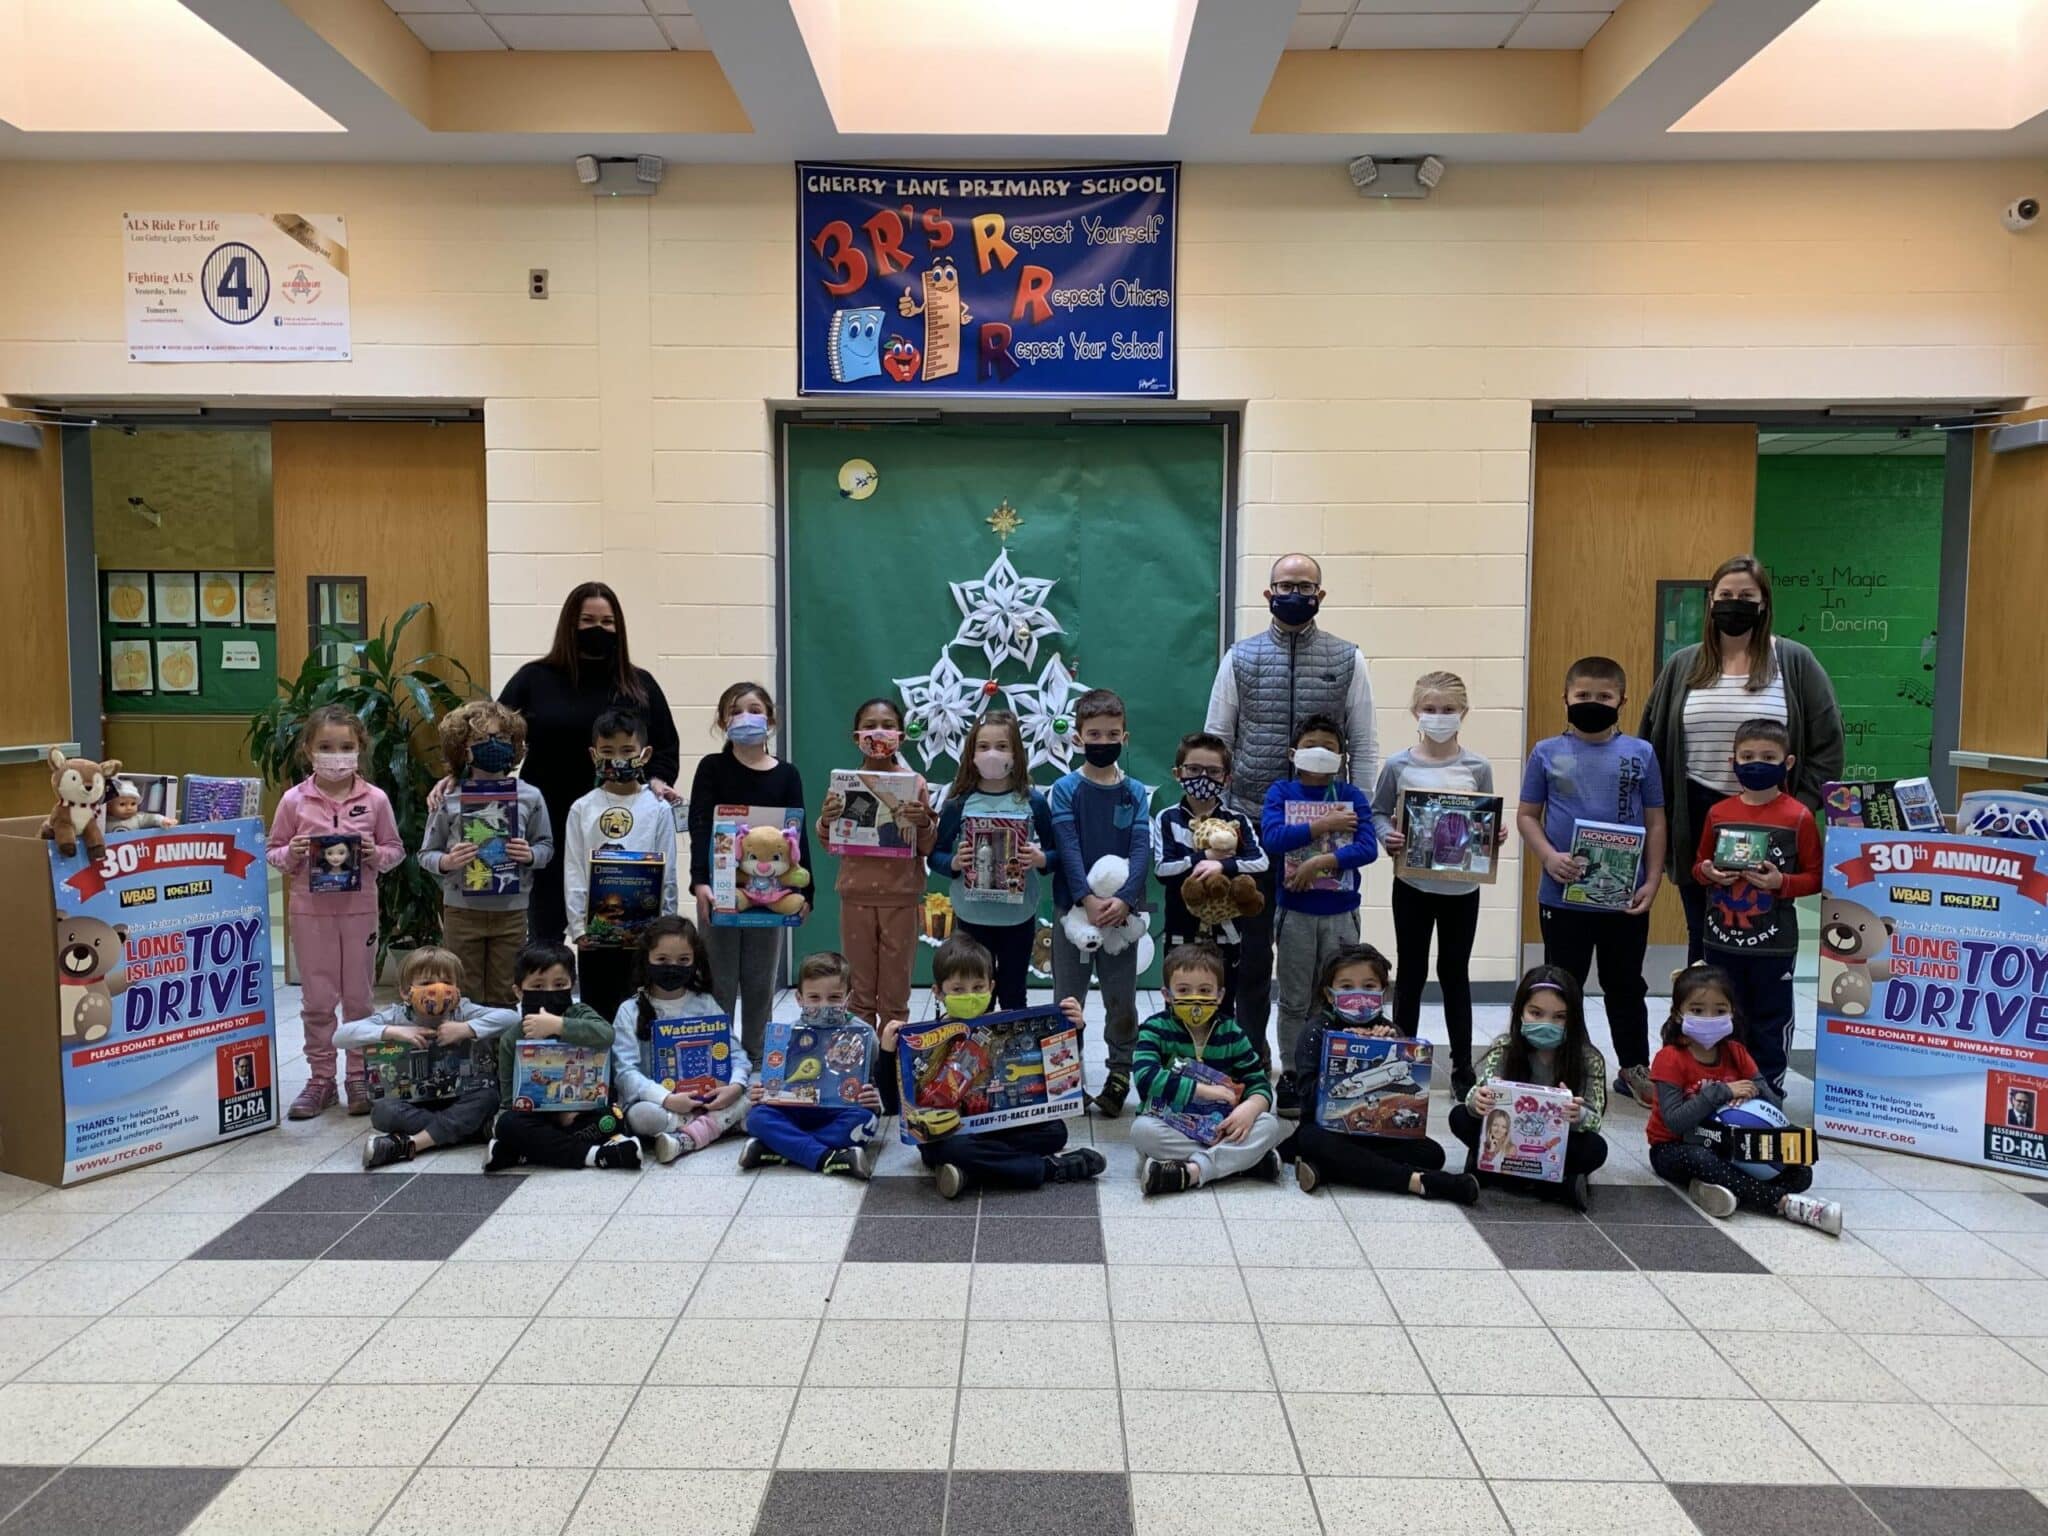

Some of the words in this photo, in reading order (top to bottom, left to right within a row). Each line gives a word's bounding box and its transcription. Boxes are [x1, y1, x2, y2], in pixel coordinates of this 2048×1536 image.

[807, 175, 886, 195] CHERRY
[897, 178, 950, 196] LANE
[959, 178, 1071, 197] PRIMARY
[1081, 175, 1166, 195] SCHOOL
[127, 220, 149, 231] ALS
[152, 219, 176, 231] Ride
[178, 219, 197, 231] For
[200, 219, 220, 231] Life
[971, 213, 1073, 275] Respect
[1081, 215, 1164, 246] Yourself
[128, 272, 169, 284] Fighting
[171, 272, 194, 283] ALS
[217, 257, 252, 310] 4
[1011, 265, 1104, 324] Respect
[1110, 279, 1169, 308] Others
[980, 322, 1064, 381] Respect
[1069, 331, 1106, 360] Your
[1111, 330, 1164, 360] School
[1833, 565, 1888, 598] Magic
[1819, 587, 1846, 609] In
[1821, 610, 1888, 642] Dancing
[1841, 719, 1877, 746] agic
[1618, 756, 1631, 825] ARMOU
[1868, 801, 1881, 827] FACT
[1582, 831, 1637, 845] MONOPOLY
[99, 842, 150, 878] 30th
[155, 842, 227, 863] ANNUAL
[1869, 844, 1928, 871] 30th
[1932, 850, 2023, 880] ANNUAL
[121, 888, 156, 904] WBAB
[1891, 887, 1930, 902] WBAB
[186, 918, 261, 971] TOY
[1707, 915, 1730, 942] NEW
[1736, 924, 1779, 947] YORK
[126, 932, 185, 961] LONG
[1891, 934, 1959, 962] LONG
[127, 957, 187, 982] ISLAND
[1890, 958, 1959, 981] ISLAND
[1961, 940, 2048, 995] TOY
[125, 962, 261, 1033] DRIVE
[1884, 978, 2048, 1043] DRIVE
[90, 1047, 120, 1060] PLEASE
[122, 1039, 156, 1053] DONATE
[158, 1037, 164, 1045] A
[166, 1032, 184, 1043] NEW
[187, 1021, 233, 1037] UNWRAPPED
[234, 1017, 249, 1026] TOY
[659, 1021, 727, 1037] Waterfuls
[921, 1032, 939, 1048] HOT
[1845, 1024, 1876, 1036] PLEASE
[1878, 1030, 1916, 1043] DONATE
[1918, 1035, 1925, 1043] A
[1927, 1037, 1949, 1047] NEW
[1953, 1041, 2013, 1057] UNWRAPPED
[2015, 1050, 2035, 1060] TOY
[1350, 1044, 1370, 1054] CITY
[1825, 1084, 1864, 1098] THANKS
[1866, 1092, 1877, 1100] for
[1880, 1094, 1911, 1108] helping
[1825, 1095, 1868, 1108] BRIGHTEN
[1871, 1102, 1887, 1111] THE
[1891, 1106, 1935, 1120] HOLIDAYS
[76, 1116, 114, 1133] THANKS
[117, 1115, 128, 1123] for
[130, 1107, 158, 1120] helping
[76, 1126, 119, 1143] BRIGHTEN
[122, 1122, 137, 1131] THE
[140, 1110, 179, 1126] HOLIDAYS
[969, 1111, 1030, 1128] READY-TO-RACE
[1031, 1108, 1046, 1117] CAR
[1047, 1102, 1079, 1114] BUILDER
[1824, 1103, 1836, 1111] for
[1838, 1106, 1853, 1114] sick
[1855, 1109, 1871, 1118] and
[1872, 1113, 1939, 1130] underprivileged
[1940, 1124, 1959, 1133] kids
[90, 1141, 104, 1150] sick
[107, 1136, 121, 1144] and
[123, 1119, 182, 1141] underprivileged
[184, 1115, 199, 1124] kids
[1825, 1121, 1916, 1145] WWW.JTCF.ORG
[75, 1142, 163, 1172] WWW.JTCF.ORG
